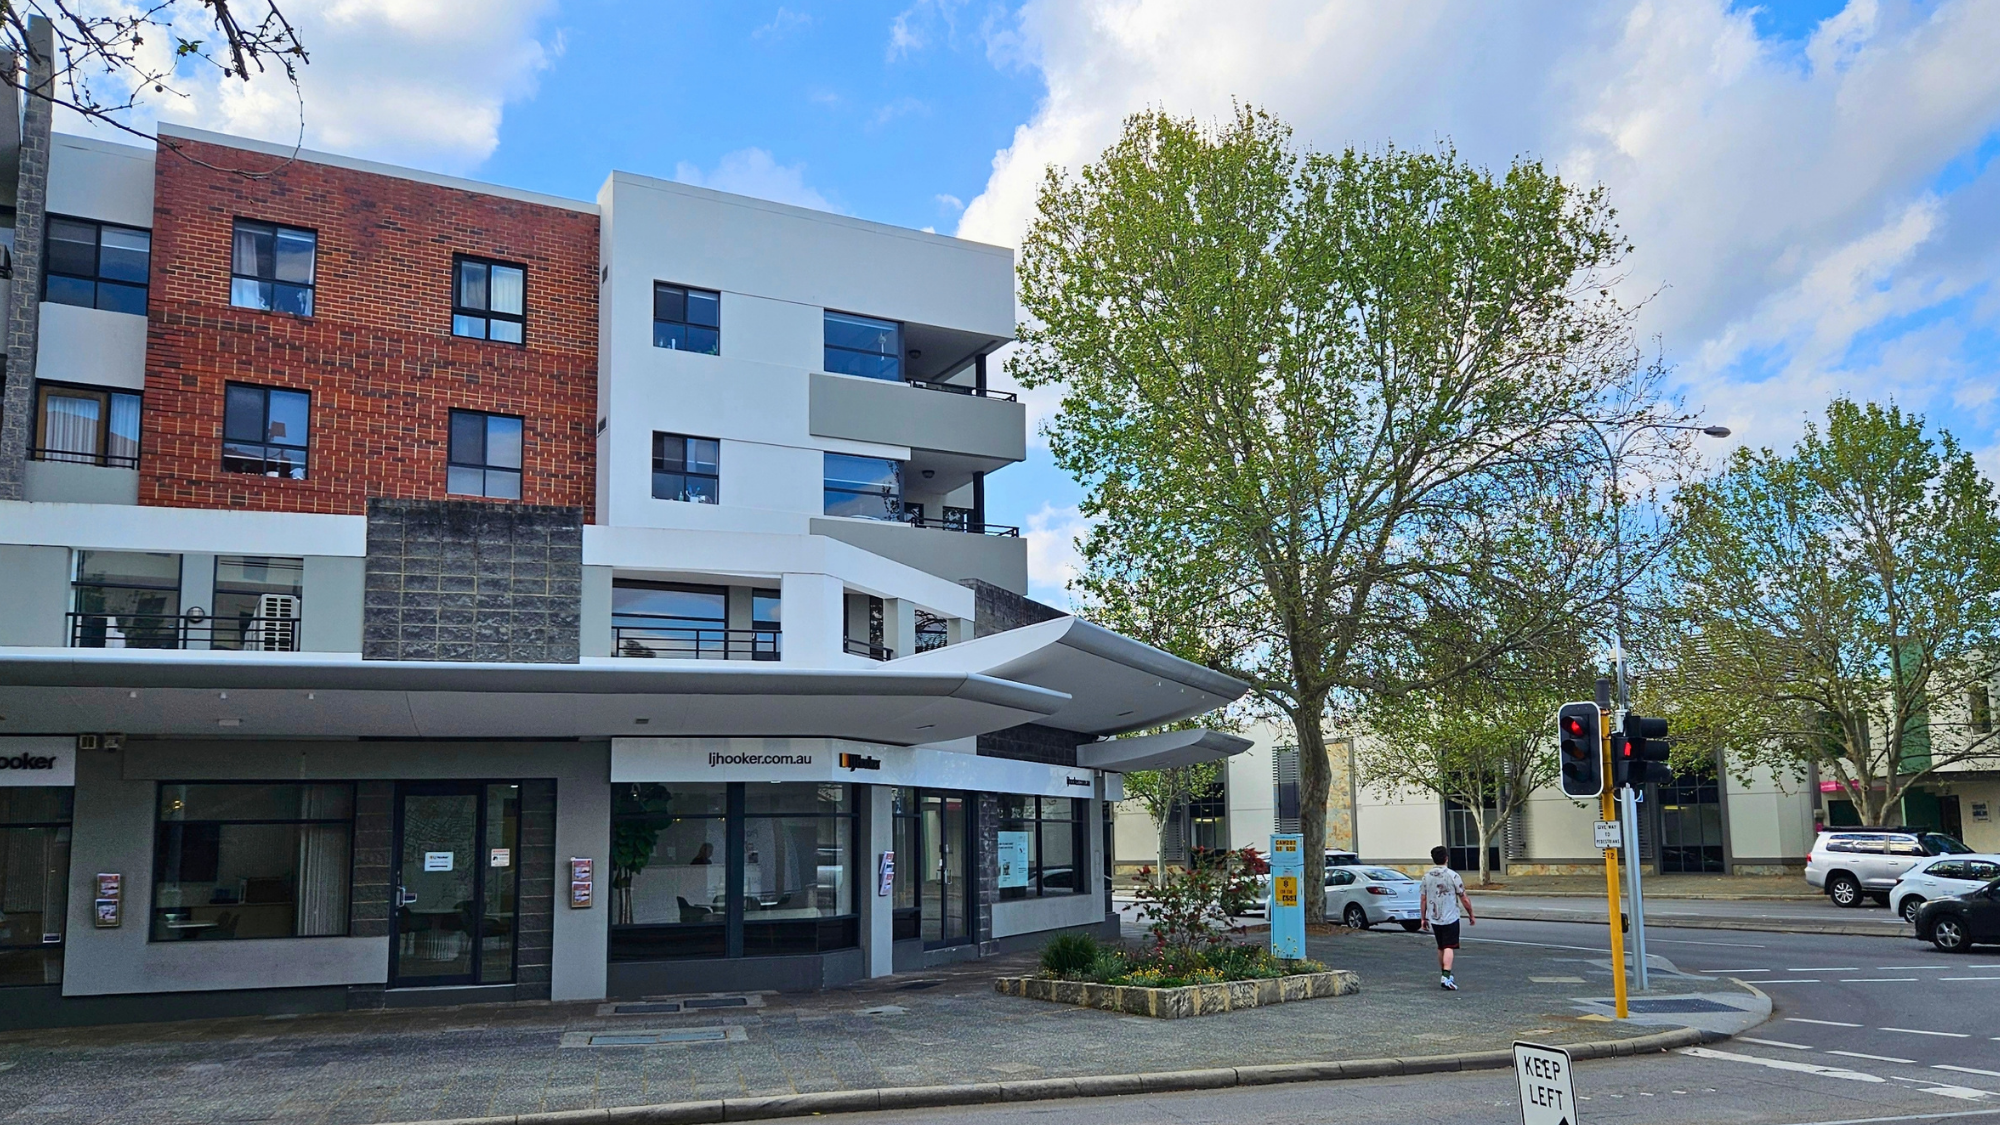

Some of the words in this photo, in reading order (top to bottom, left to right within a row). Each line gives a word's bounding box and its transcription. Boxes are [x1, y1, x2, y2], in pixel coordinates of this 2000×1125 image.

[0, 752, 57, 770] ooker
[708, 752, 812, 768] ljhooker.com.au
[1523, 1055, 1561, 1081] KEEP
[1529, 1083, 1563, 1110] LEFT
